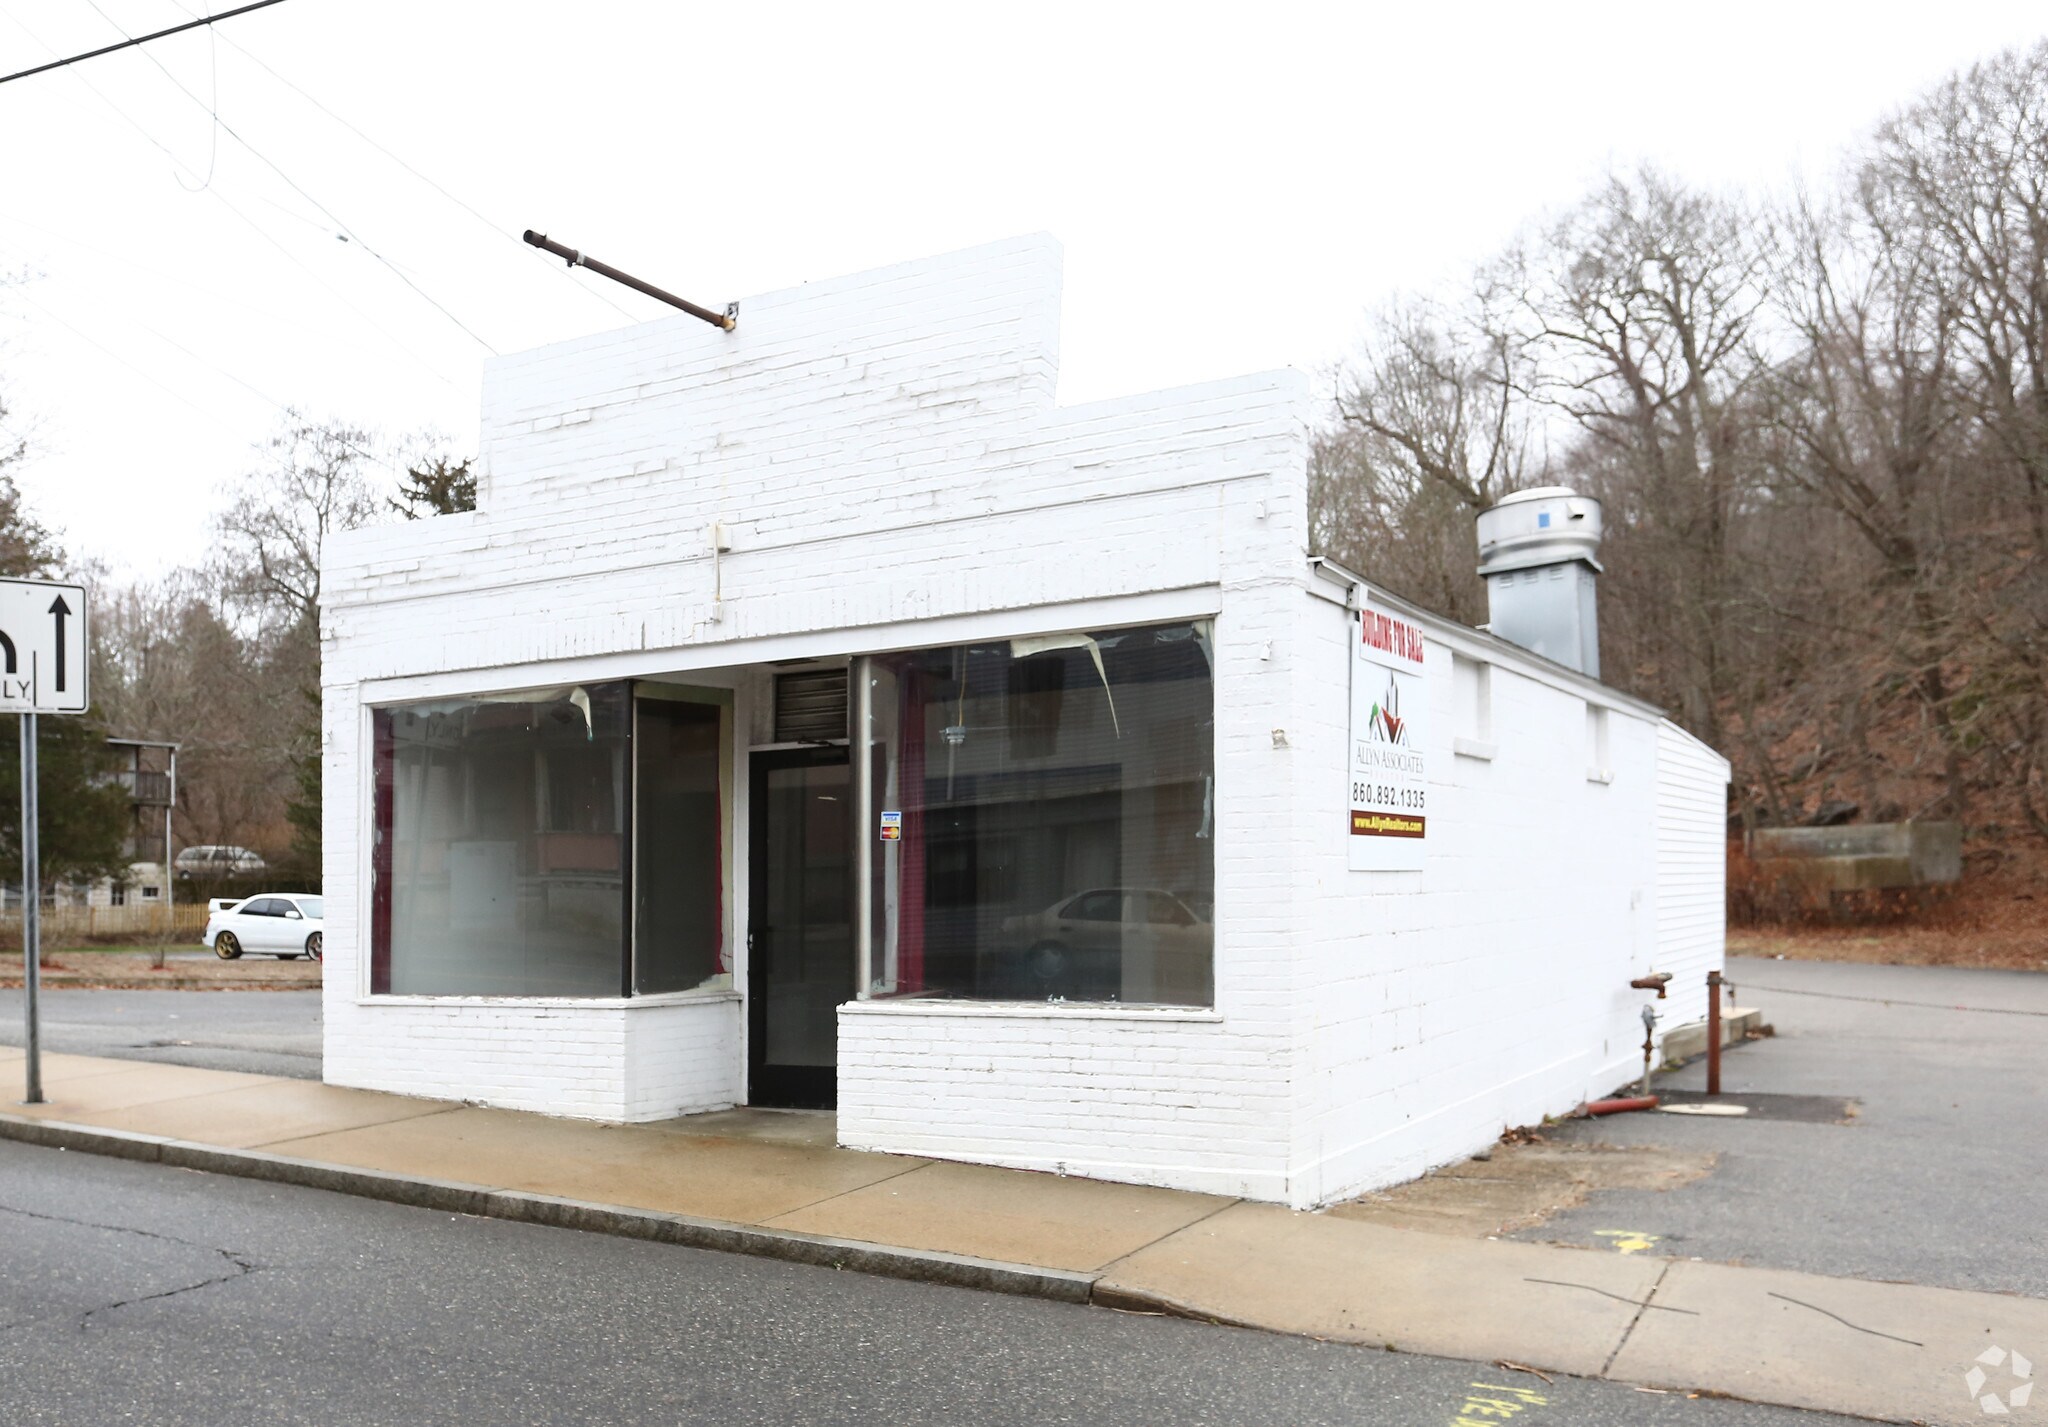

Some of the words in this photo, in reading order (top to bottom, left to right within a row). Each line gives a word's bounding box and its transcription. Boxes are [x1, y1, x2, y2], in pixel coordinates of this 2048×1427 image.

[1357, 745, 1379, 765] ALLYN
[1382, 749, 1423, 774] ASSOCIATES
[1353, 782, 1425, 808] 860.892.1335
